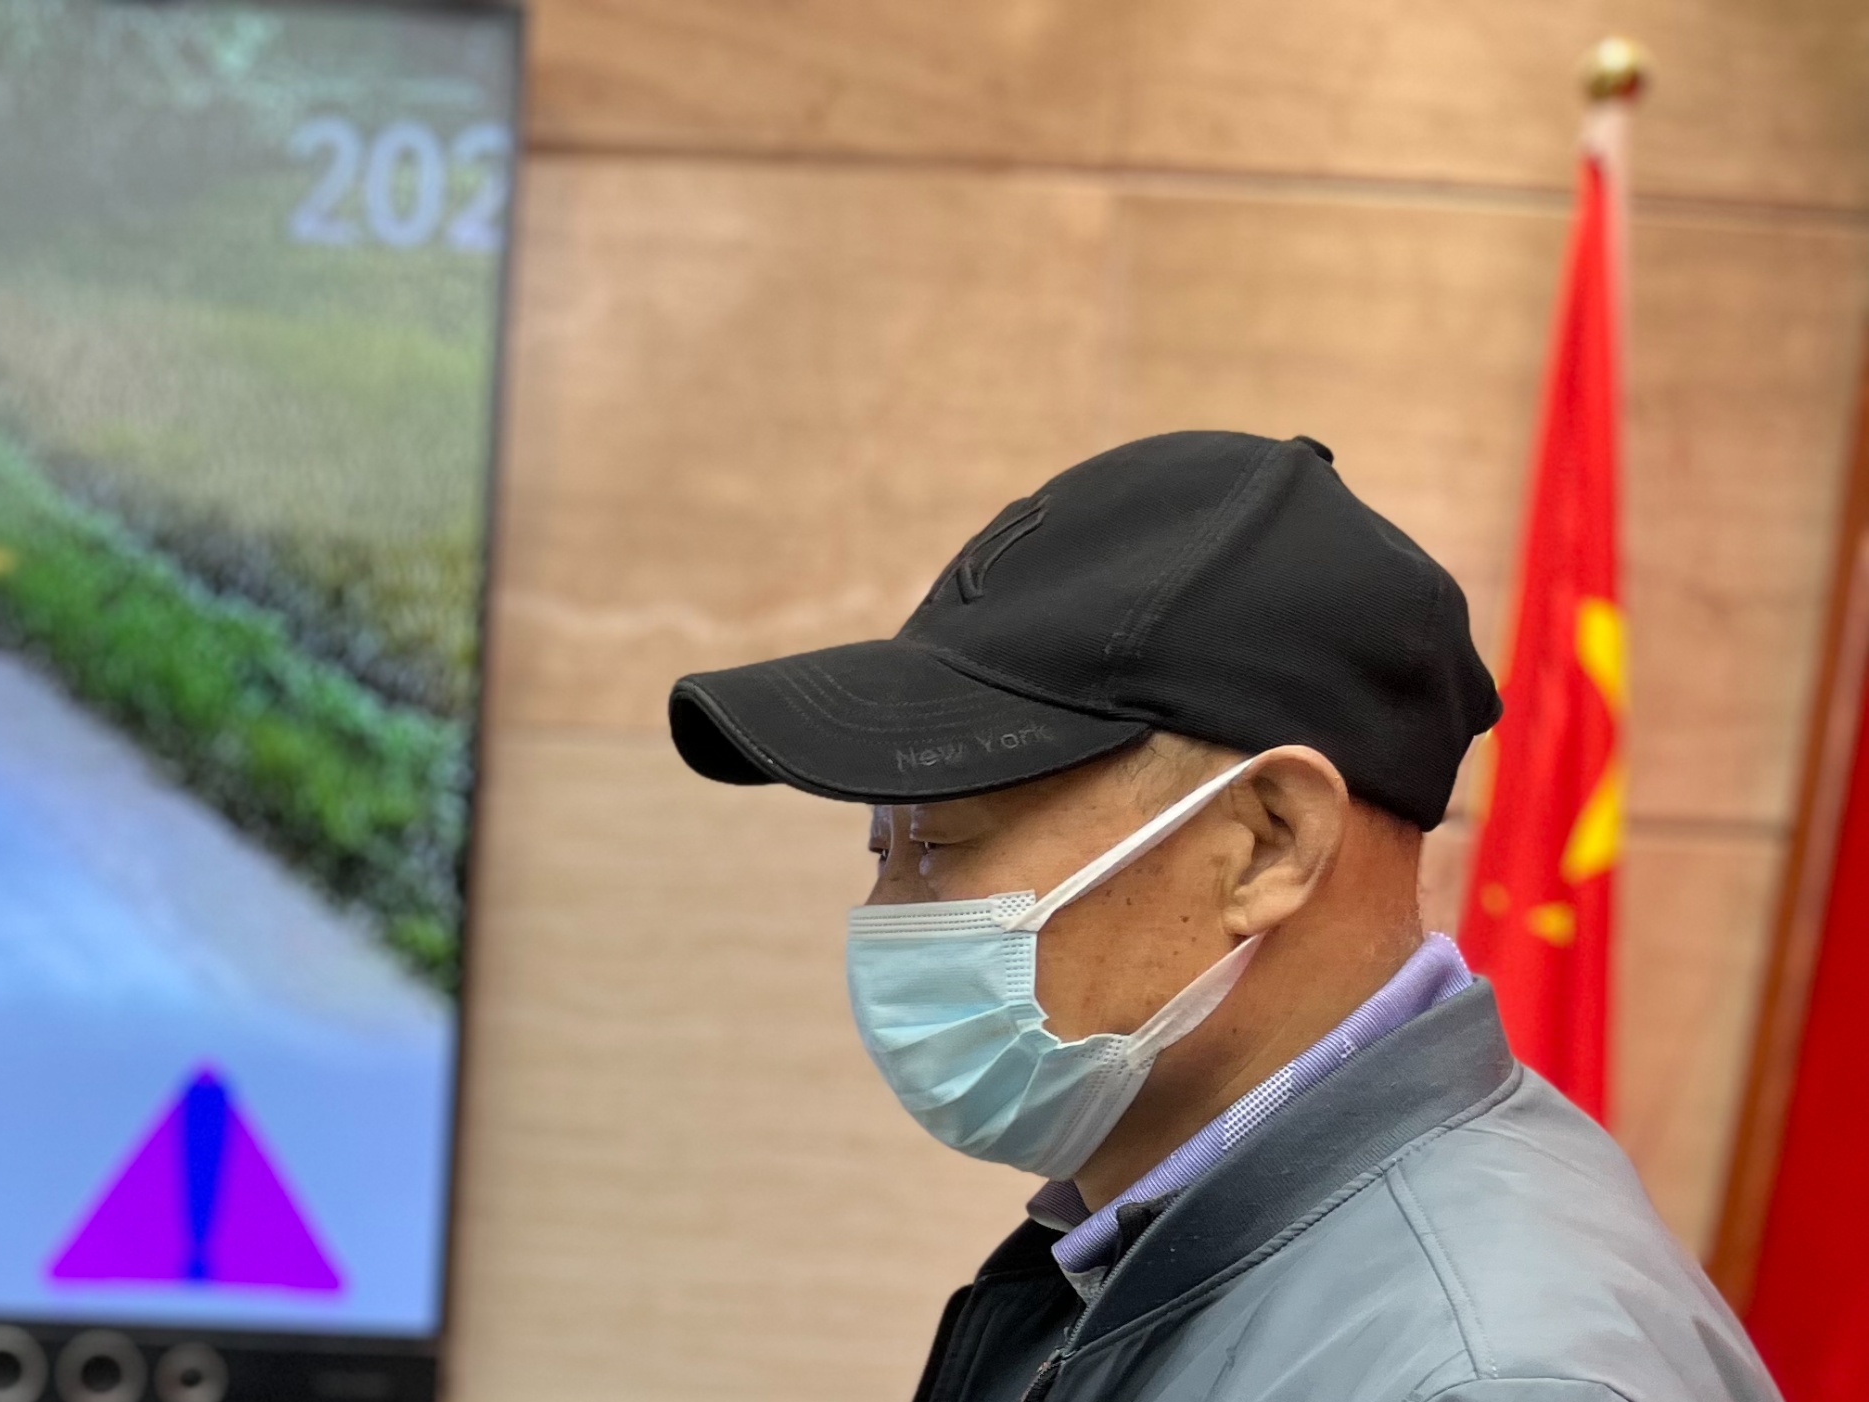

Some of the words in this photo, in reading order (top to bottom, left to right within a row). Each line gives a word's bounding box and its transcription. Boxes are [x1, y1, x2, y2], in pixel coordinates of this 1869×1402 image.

[287, 113, 516, 252] 202
[895, 742, 966, 773] New
[975, 721, 1055, 753] York
